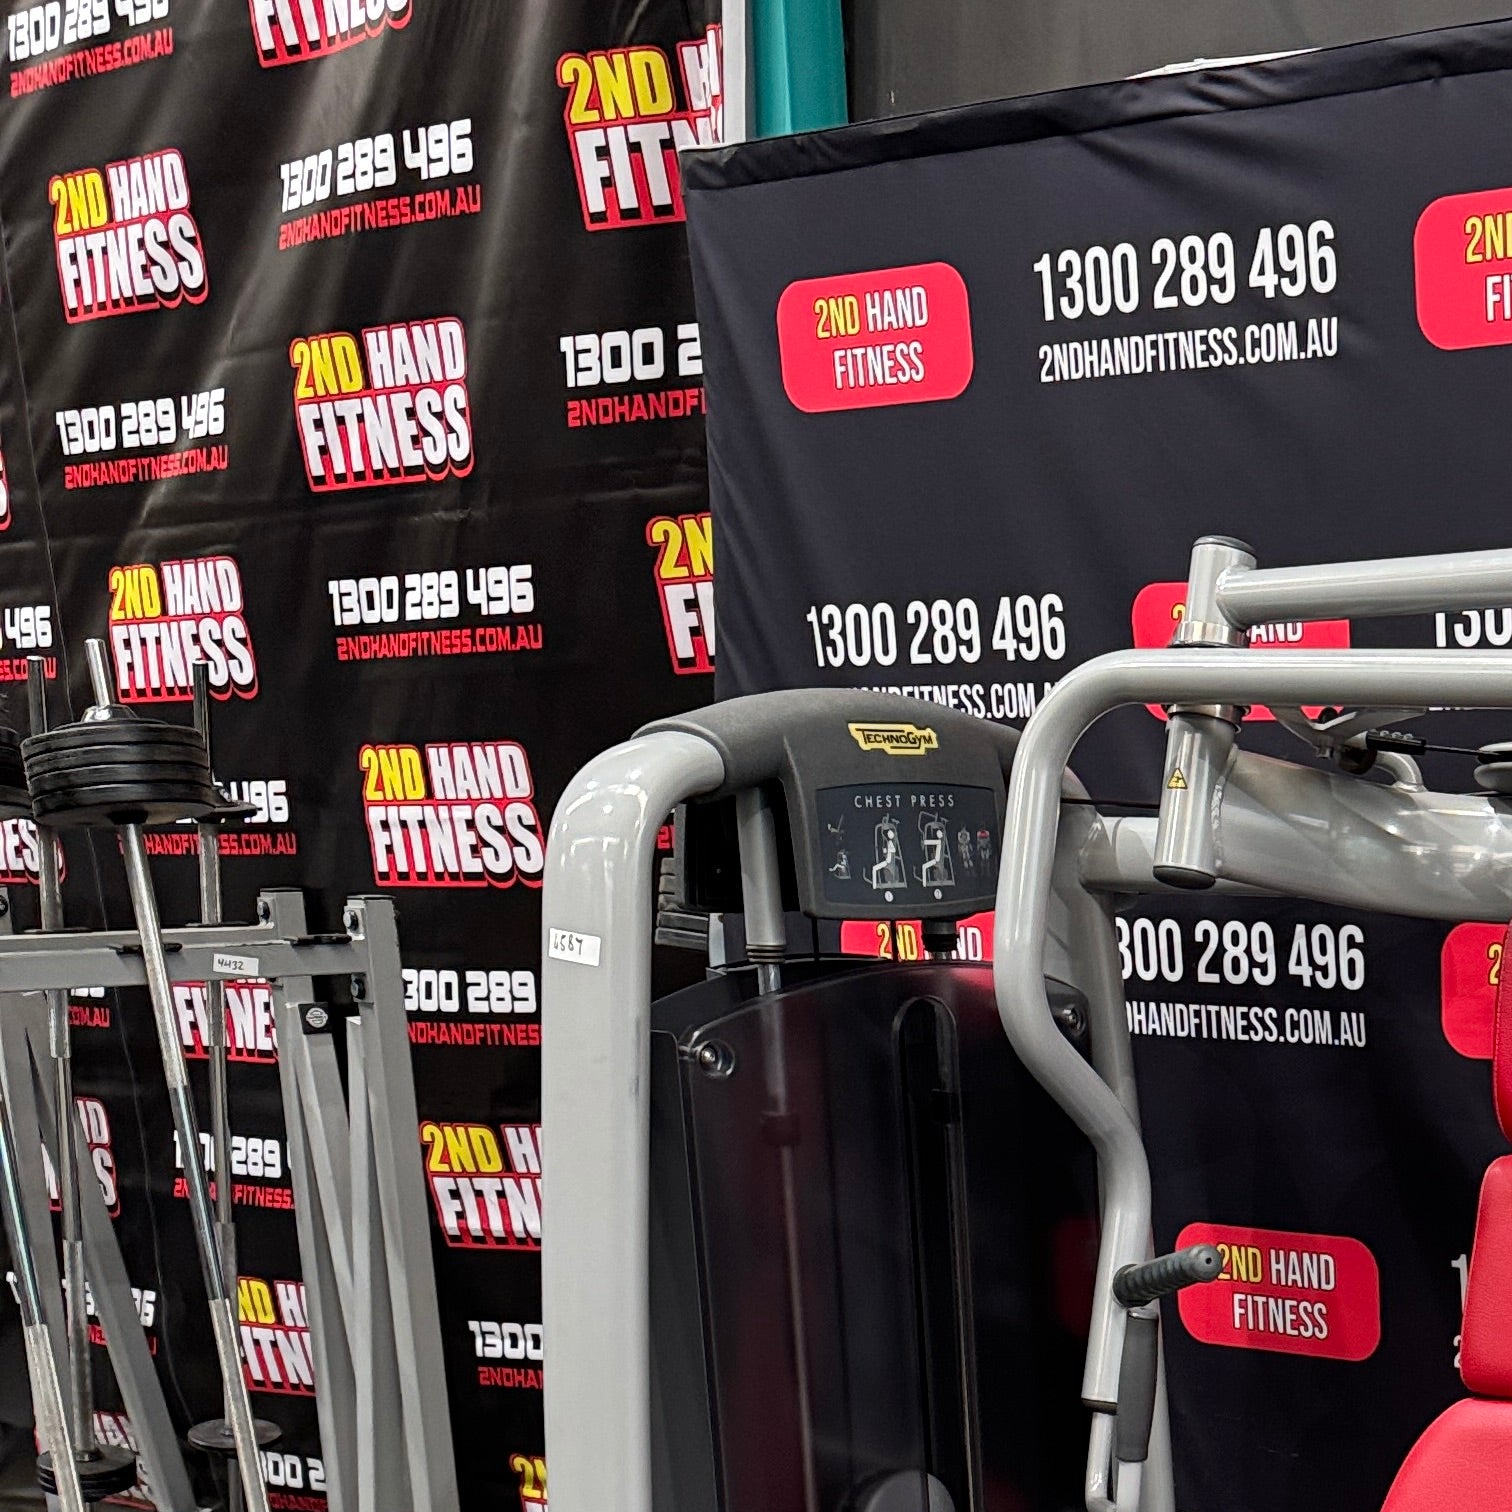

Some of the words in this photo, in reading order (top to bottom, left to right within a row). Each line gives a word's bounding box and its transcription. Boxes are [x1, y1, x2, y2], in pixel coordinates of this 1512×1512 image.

[8, 1, 61, 61] 1300
[10, 27, 173, 98] 2NDHANDFITNESS.COM.AU
[561, 51, 673, 124] 2ND
[51, 171, 108, 236] 2ND
[108, 152, 188, 222] HAND
[281, 149, 332, 213] 1300
[337, 133, 396, 195] 289
[403, 118, 473, 180] 496
[279, 184, 481, 250] 2NDHANDFITNESS.COM.AU
[58, 213, 205, 309] FITNESS
[1034, 242, 1141, 322] 1300
[1151, 231, 1236, 310] 289
[1247, 220, 1338, 301] 496
[814, 295, 861, 340] 2ND
[866, 286, 929, 333] HAND
[293, 336, 363, 399] 2ND
[365, 321, 465, 389] HAND
[560, 327, 664, 387] 1300
[833, 340, 925, 390] FITNESS
[1038, 316, 1338, 383] 2NDHANDFITNESS.COM.AU
[56, 406, 116, 455] 1300
[121, 398, 176, 448] 289
[181, 388, 225, 439] 496
[299, 384, 470, 476] FITNESS
[64, 445, 228, 490] 2NDHANDFITNESS.COM.AU
[651, 517, 713, 580] 2N
[111, 567, 161, 620] 2ND
[162, 560, 241, 616] HAND
[328, 576, 399, 626] 1300
[405, 570, 460, 621] 289
[466, 564, 534, 616] 496
[5, 605, 51, 649] 496
[111, 616, 255, 690] FITNESS
[336, 624, 543, 661] 2NDHANDFITNESS.COM.AU
[807, 602, 897, 667] 1300
[907, 598, 981, 664] 289
[992, 594, 1066, 661] 496
[1247, 621, 1303, 643] AND
[855, 728, 933, 749] TECHNOGYM
[362, 748, 425, 800] 2ND
[427, 745, 530, 799] HAND
[854, 795, 900, 809] CHEST
[911, 795, 954, 808] PRESS
[368, 803, 544, 873] FITNESS
[1115, 916, 1184, 983] 300
[1194, 920, 1276, 986] 289
[1288, 924, 1365, 991] 496
[401, 969, 460, 1012] 300
[466, 971, 537, 1013] 289
[407, 1021, 542, 1046] NDHANDFITNES
[1126, 1000, 1366, 1048] HANDFITNESS.COM.AU
[231, 1136, 281, 1178] 289
[422, 1124, 503, 1172] 2ND
[433, 1177, 542, 1238] FITN
[1216, 1243, 1263, 1284] 2ND
[1269, 1249, 1336, 1291] HAND
[238, 1278, 276, 1324] ND
[1233, 1293, 1328, 1340] FITNESS
[468, 1320, 543, 1360] 1300
